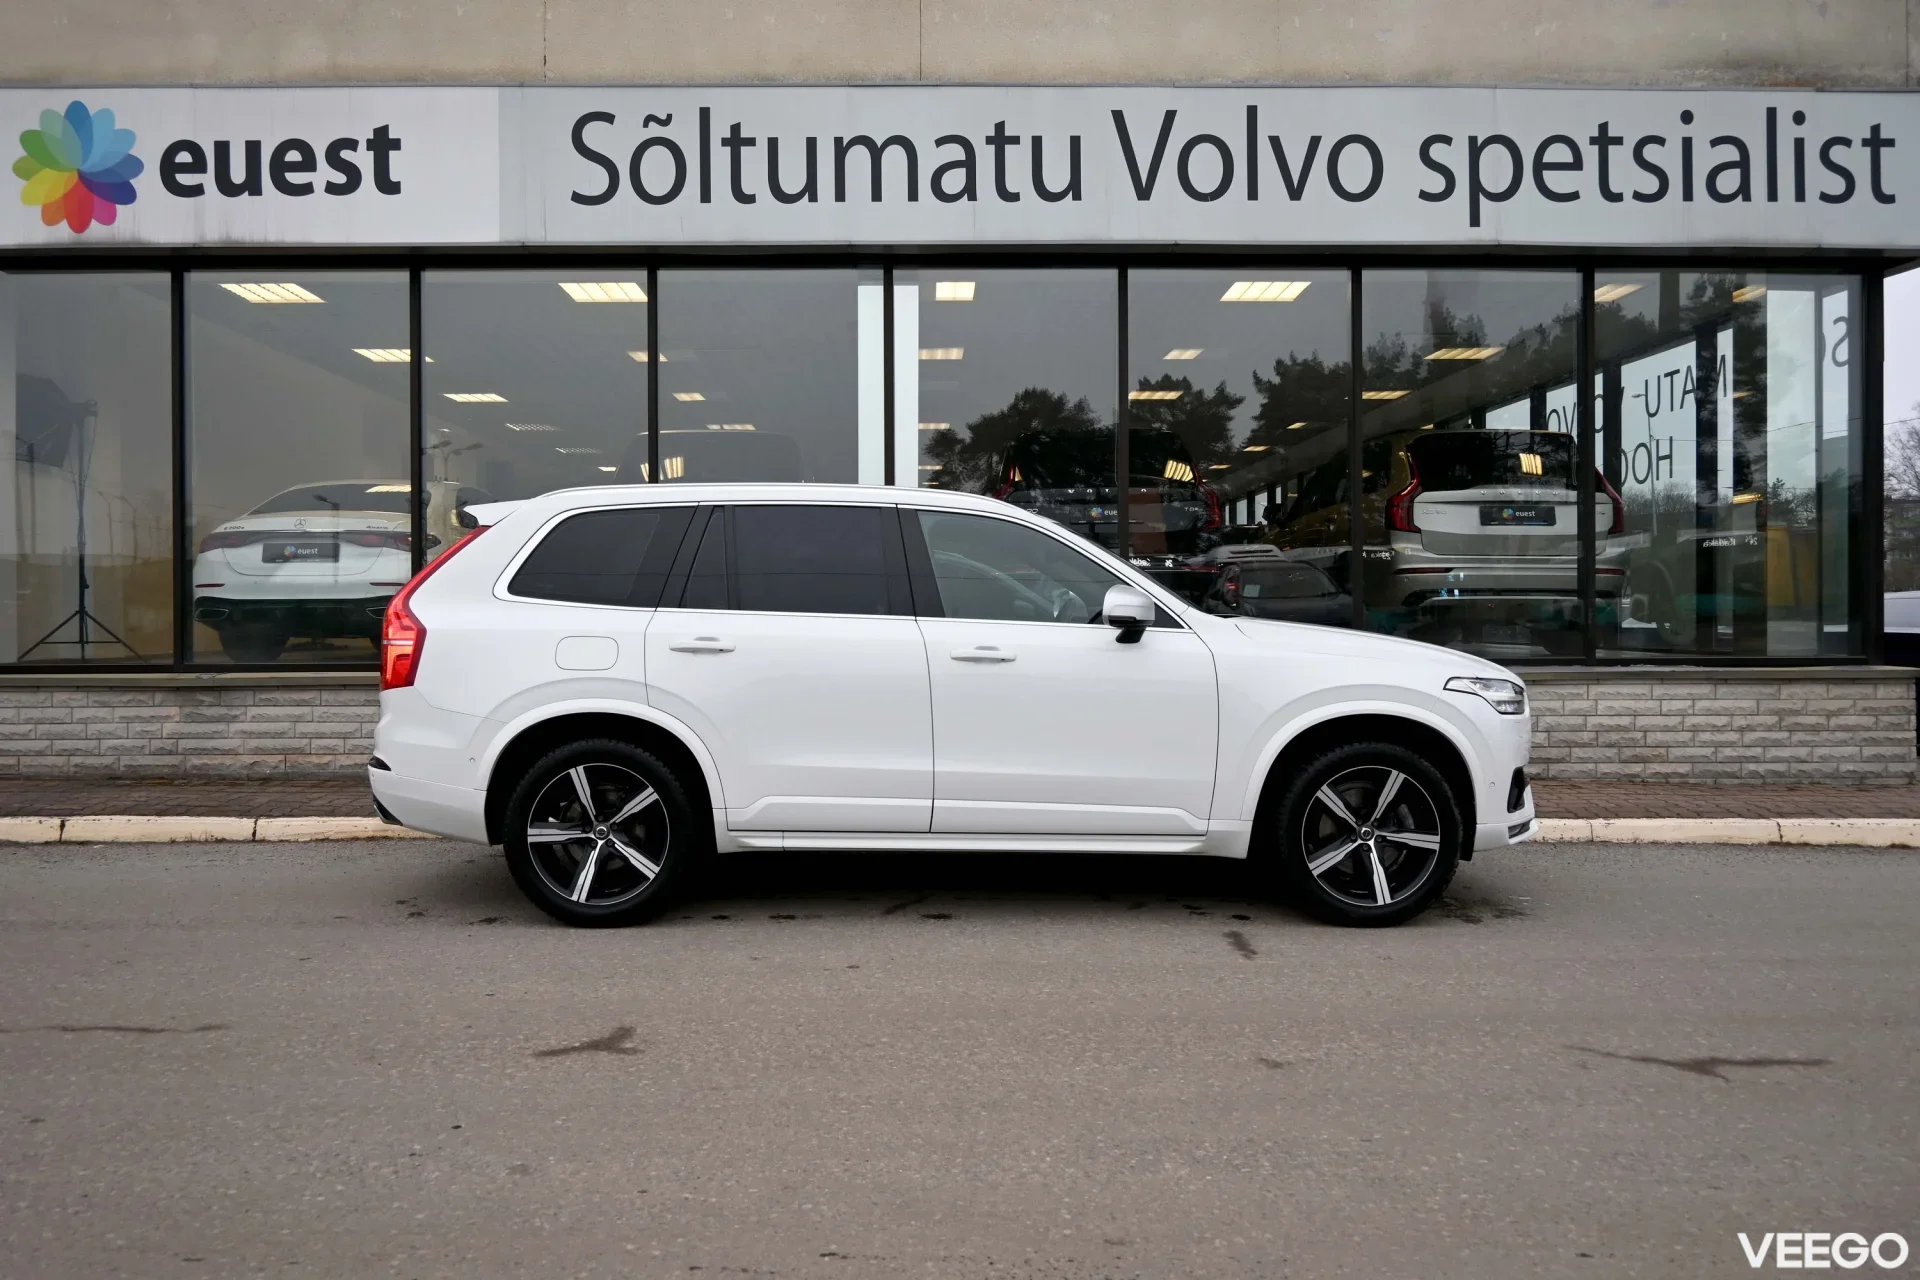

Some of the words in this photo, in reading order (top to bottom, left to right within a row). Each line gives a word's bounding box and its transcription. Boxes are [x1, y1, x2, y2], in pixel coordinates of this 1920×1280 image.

[159, 123, 402, 199] euest
[570, 106, 1083, 207] Sõltumatu
[1110, 104, 1384, 204] Volvo
[1418, 106, 1897, 228] spetsialist
